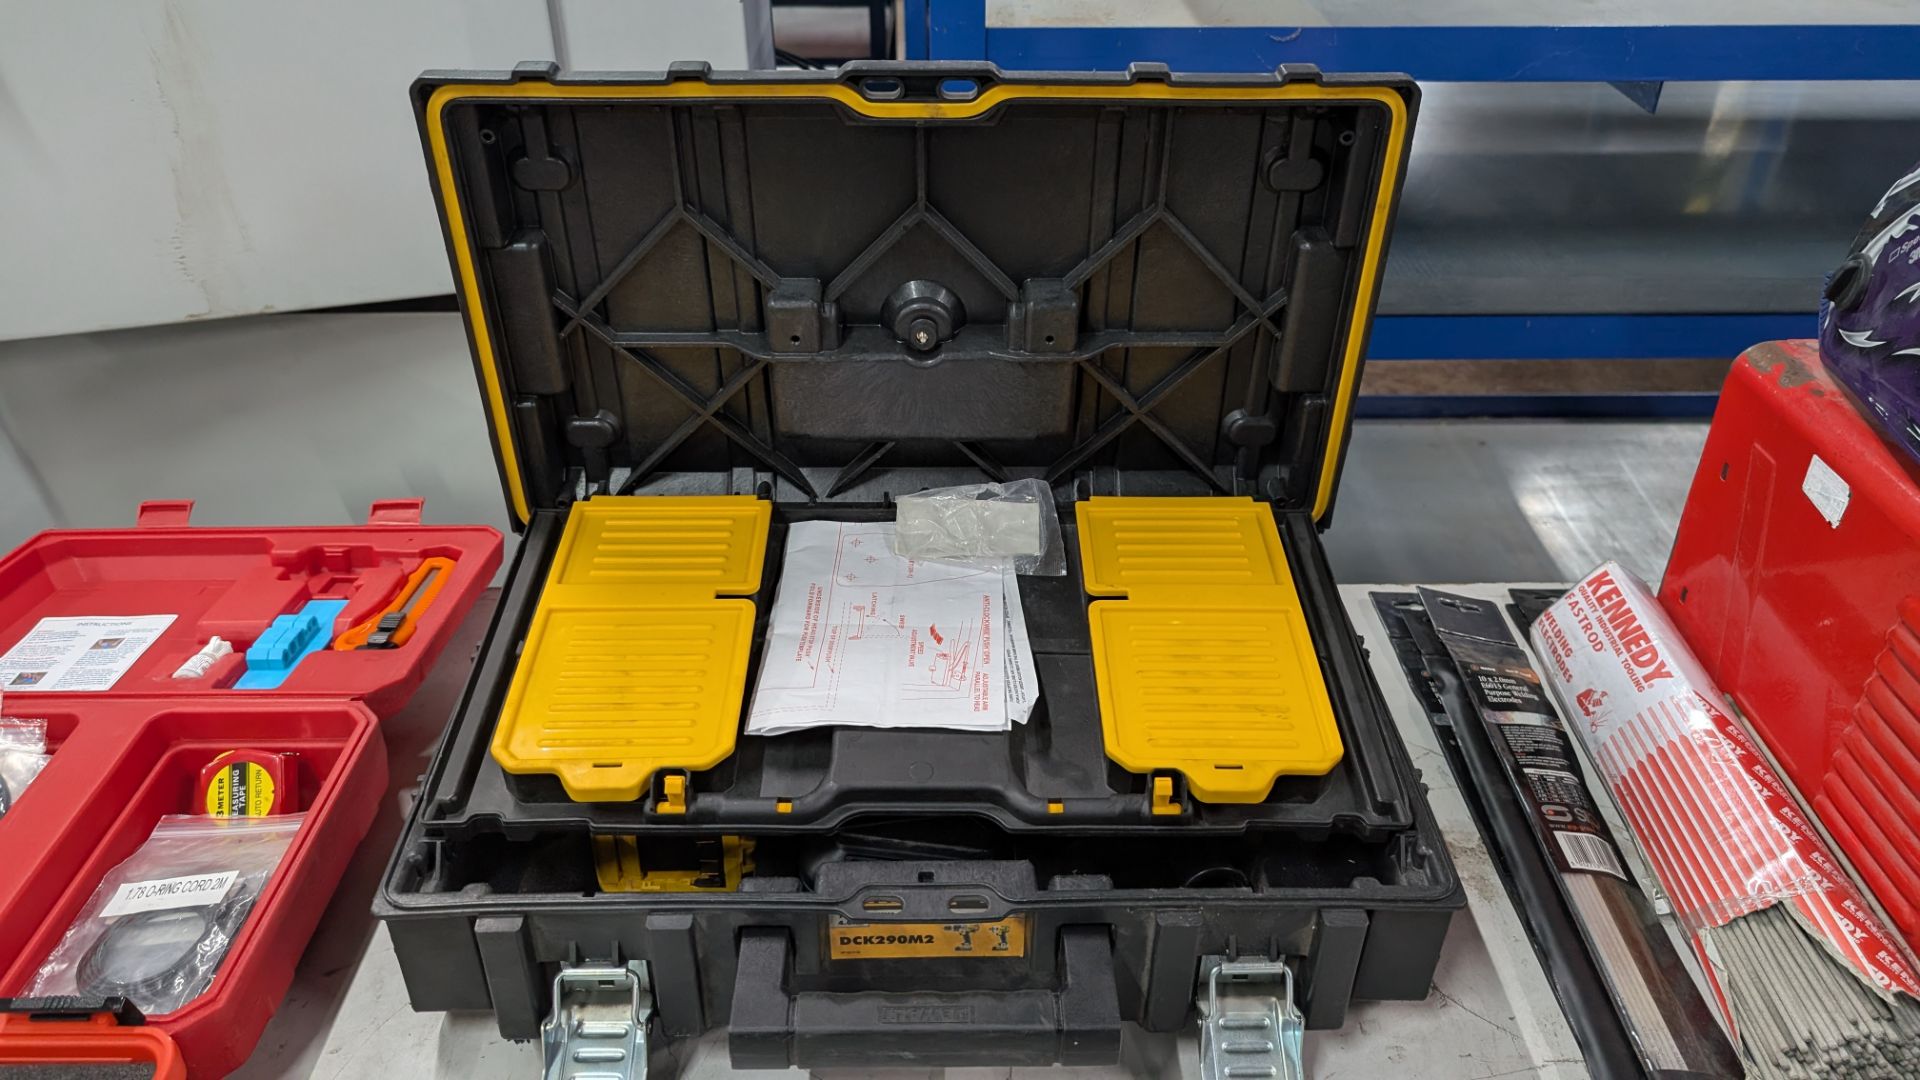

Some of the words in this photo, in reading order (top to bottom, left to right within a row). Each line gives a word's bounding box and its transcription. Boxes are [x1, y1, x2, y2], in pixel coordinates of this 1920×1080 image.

[1543, 610, 1573, 658] WELDING
[1564, 592, 1605, 653] FASTROD
[1586, 570, 1674, 684] KENNEDY
[1537, 619, 1573, 684] ELECTRODES
[1578, 585, 1598, 613] QUALITY
[1595, 615, 1623, 658] INDUSTRIAL
[1621, 657, 1646, 693] TOOLING
[1484, 689, 1511, 697] Purpose
[1512, 690, 1540, 702] Welding
[1487, 696, 1523, 704] Electrodes
[1503, 683, 1529, 692] General
[217, 777, 225, 809] METER
[231, 769, 240, 816] EASURING
[239, 785, 247, 808] TAPE
[125, 886, 144, 900] 1.78
[145, 881, 182, 898] O-RING
[182, 878, 211, 893] CORD
[211, 876, 229, 890] 2M
[840, 934, 935, 946] DCK290M2
